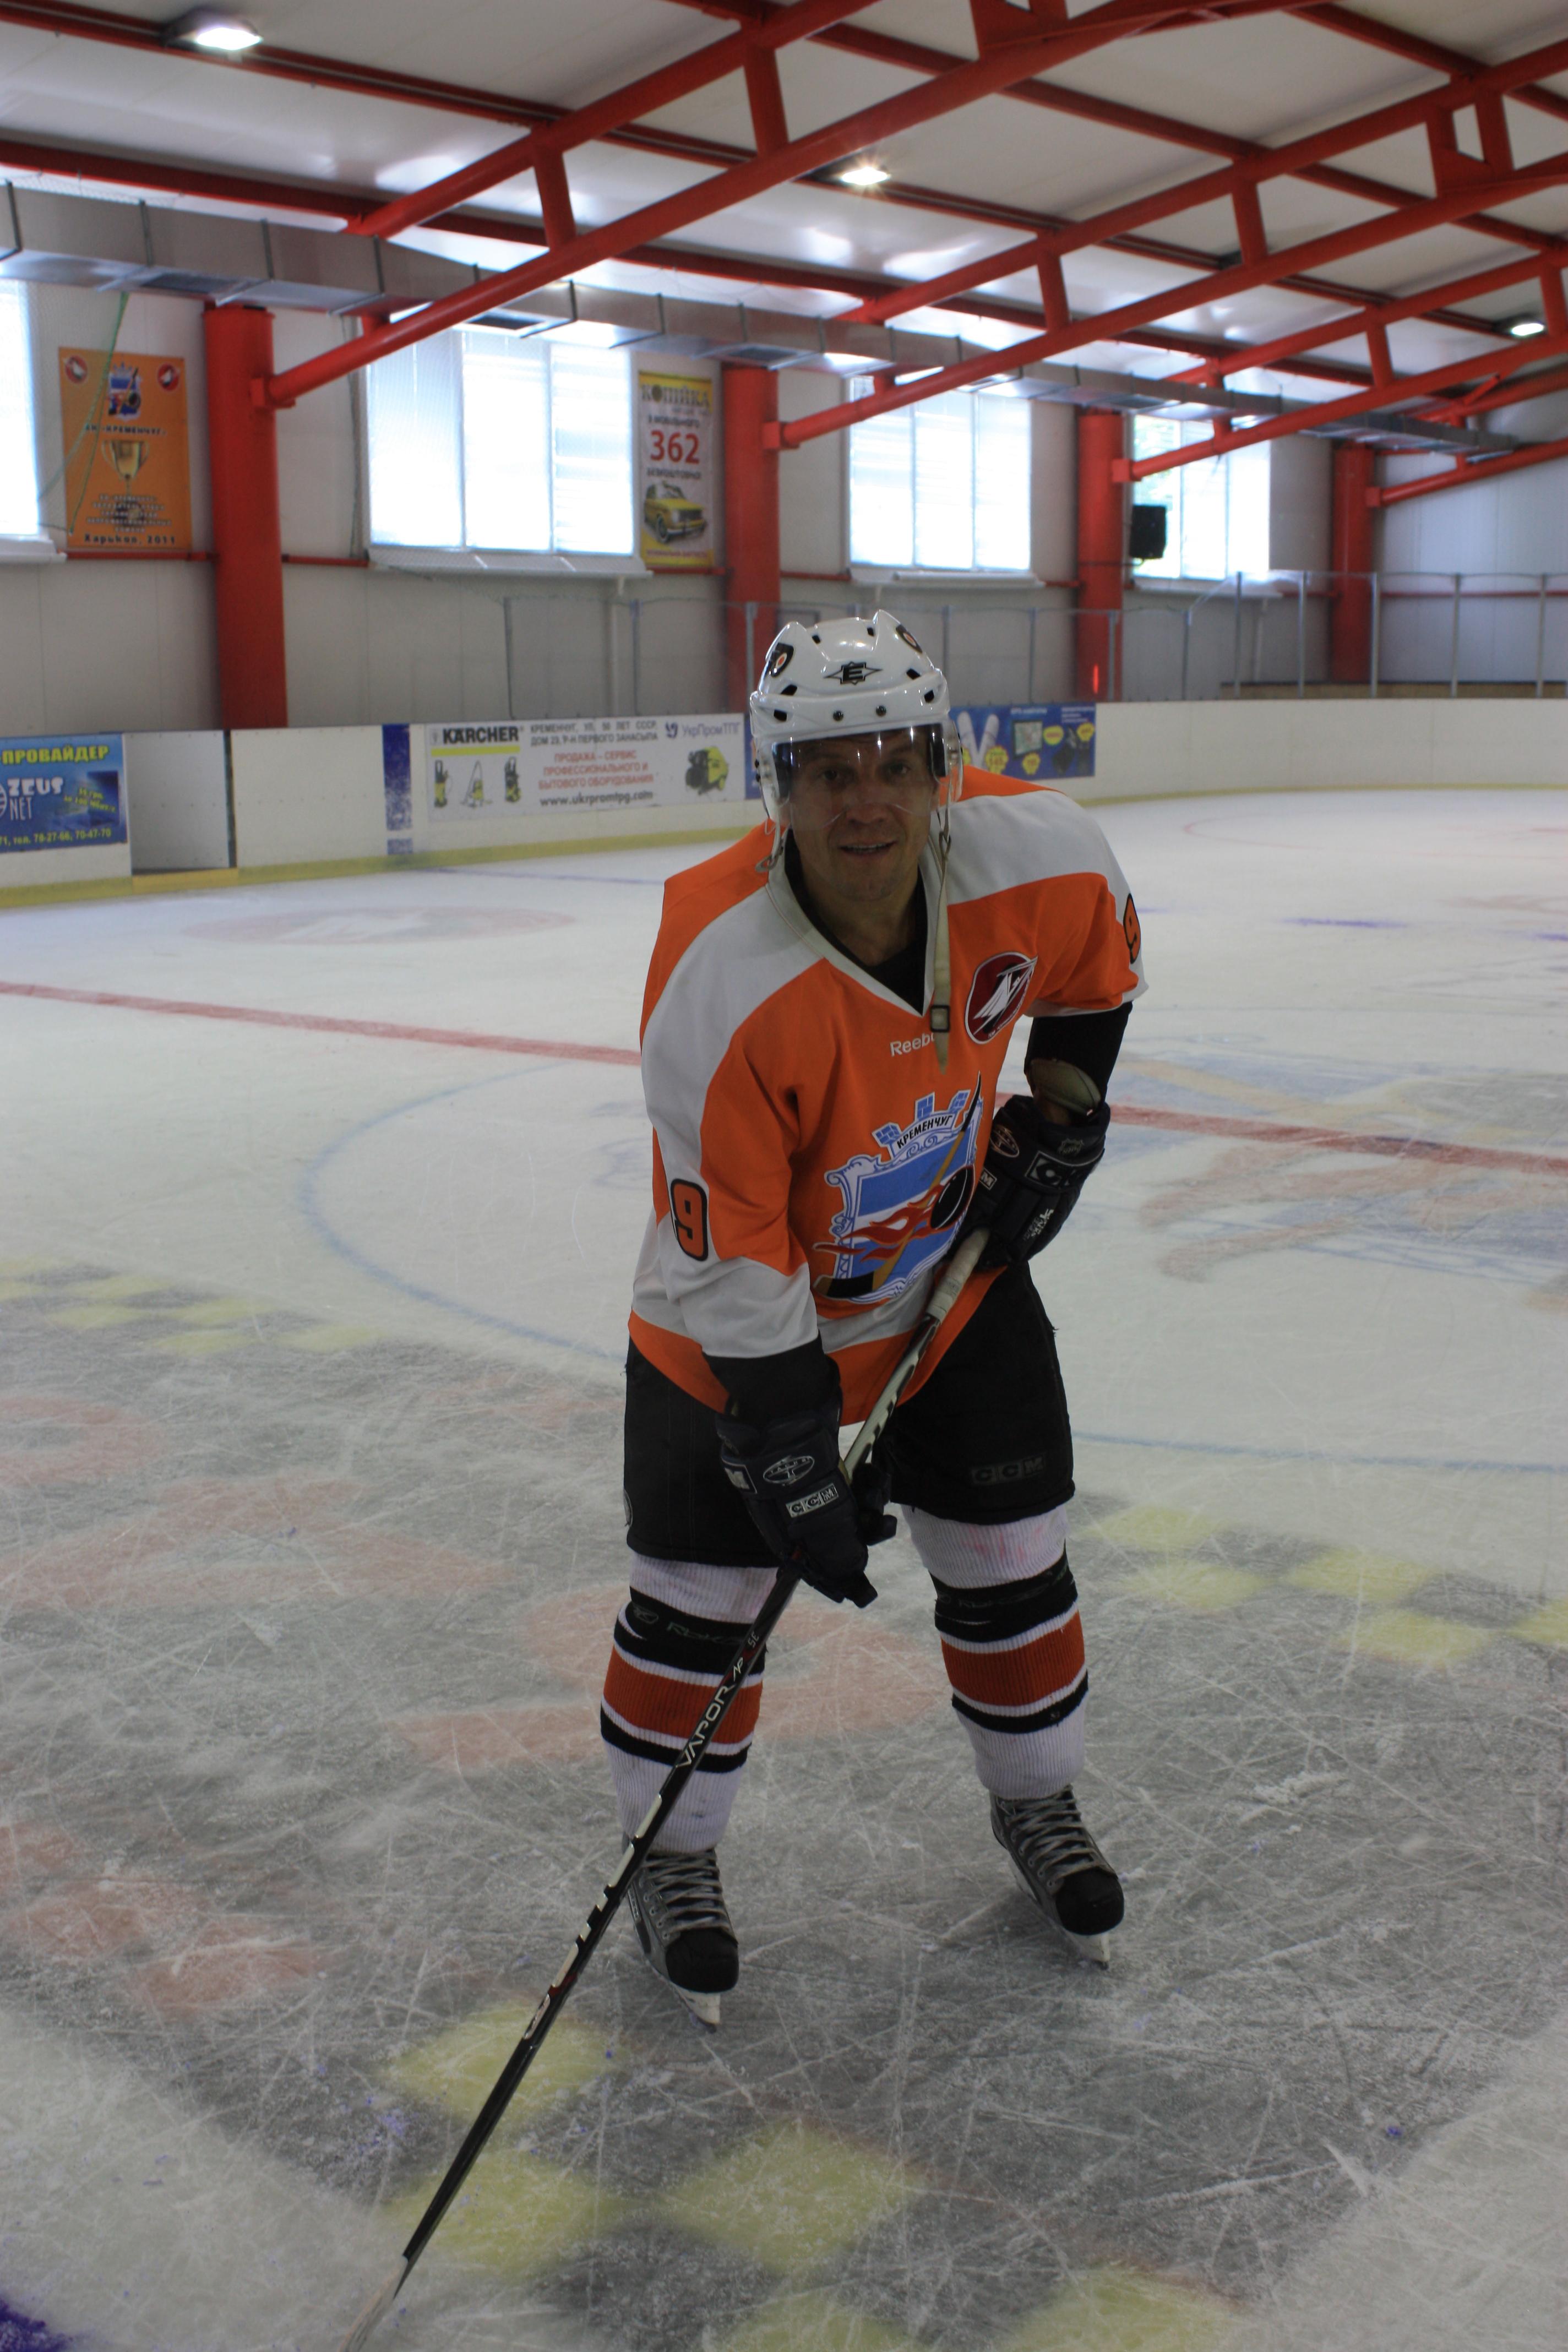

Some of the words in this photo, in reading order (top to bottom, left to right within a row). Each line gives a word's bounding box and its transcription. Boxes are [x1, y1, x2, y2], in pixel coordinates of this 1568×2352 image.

[650, 430, 700, 465] 362
[2, 744, 109, 765] ПРОВАЙДЕР
[554, 752, 596, 764] ПРОДАЖА
[605, 750, 637, 761] СЕРВИС
[7, 777, 64, 796] ZEUS
[9, 797, 33, 820] NET
[890, 1032, 934, 1057] Reeb
[896, 1115, 953, 1149] КРЕМЕНЧУГ
[670, 1178, 709, 1262] 9
[788, 1485, 837, 1516] CCM
[676, 1683, 735, 1767] VAPOR
